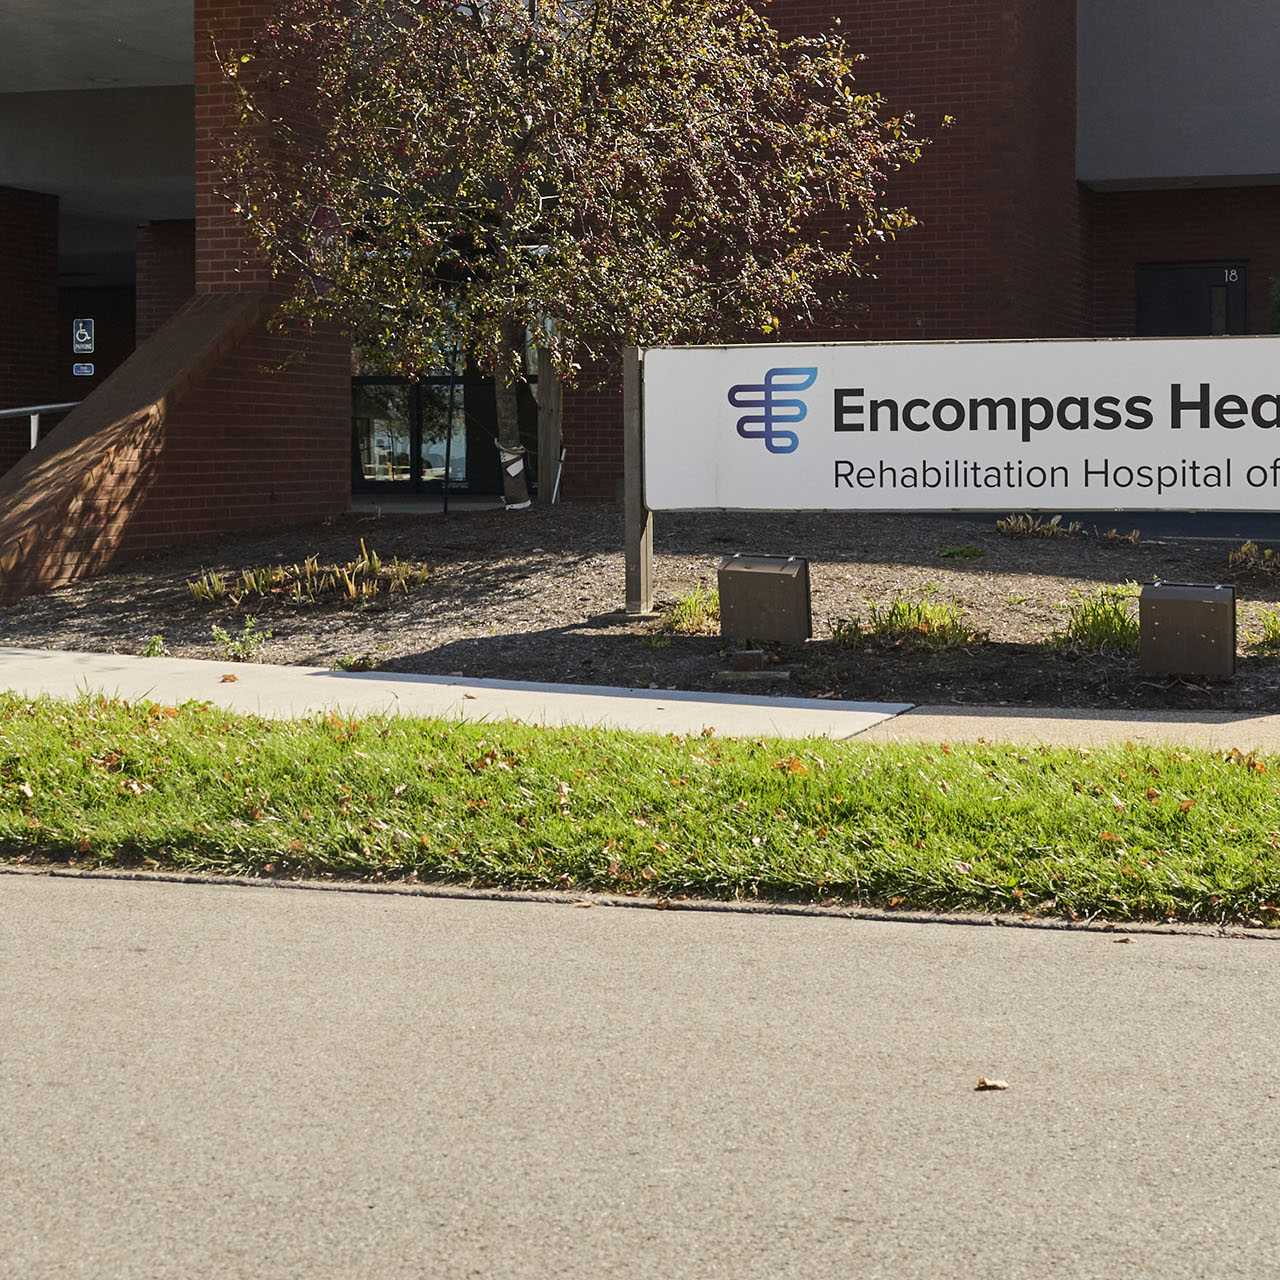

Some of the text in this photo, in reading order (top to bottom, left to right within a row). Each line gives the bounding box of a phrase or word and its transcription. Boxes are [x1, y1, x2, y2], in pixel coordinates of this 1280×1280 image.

[1224, 269, 1238, 282] 18
[834, 388, 1153, 442] Encompass
[834, 460, 1068, 489] Rehabilitation
[1084, 458, 1231, 494] Hospital
